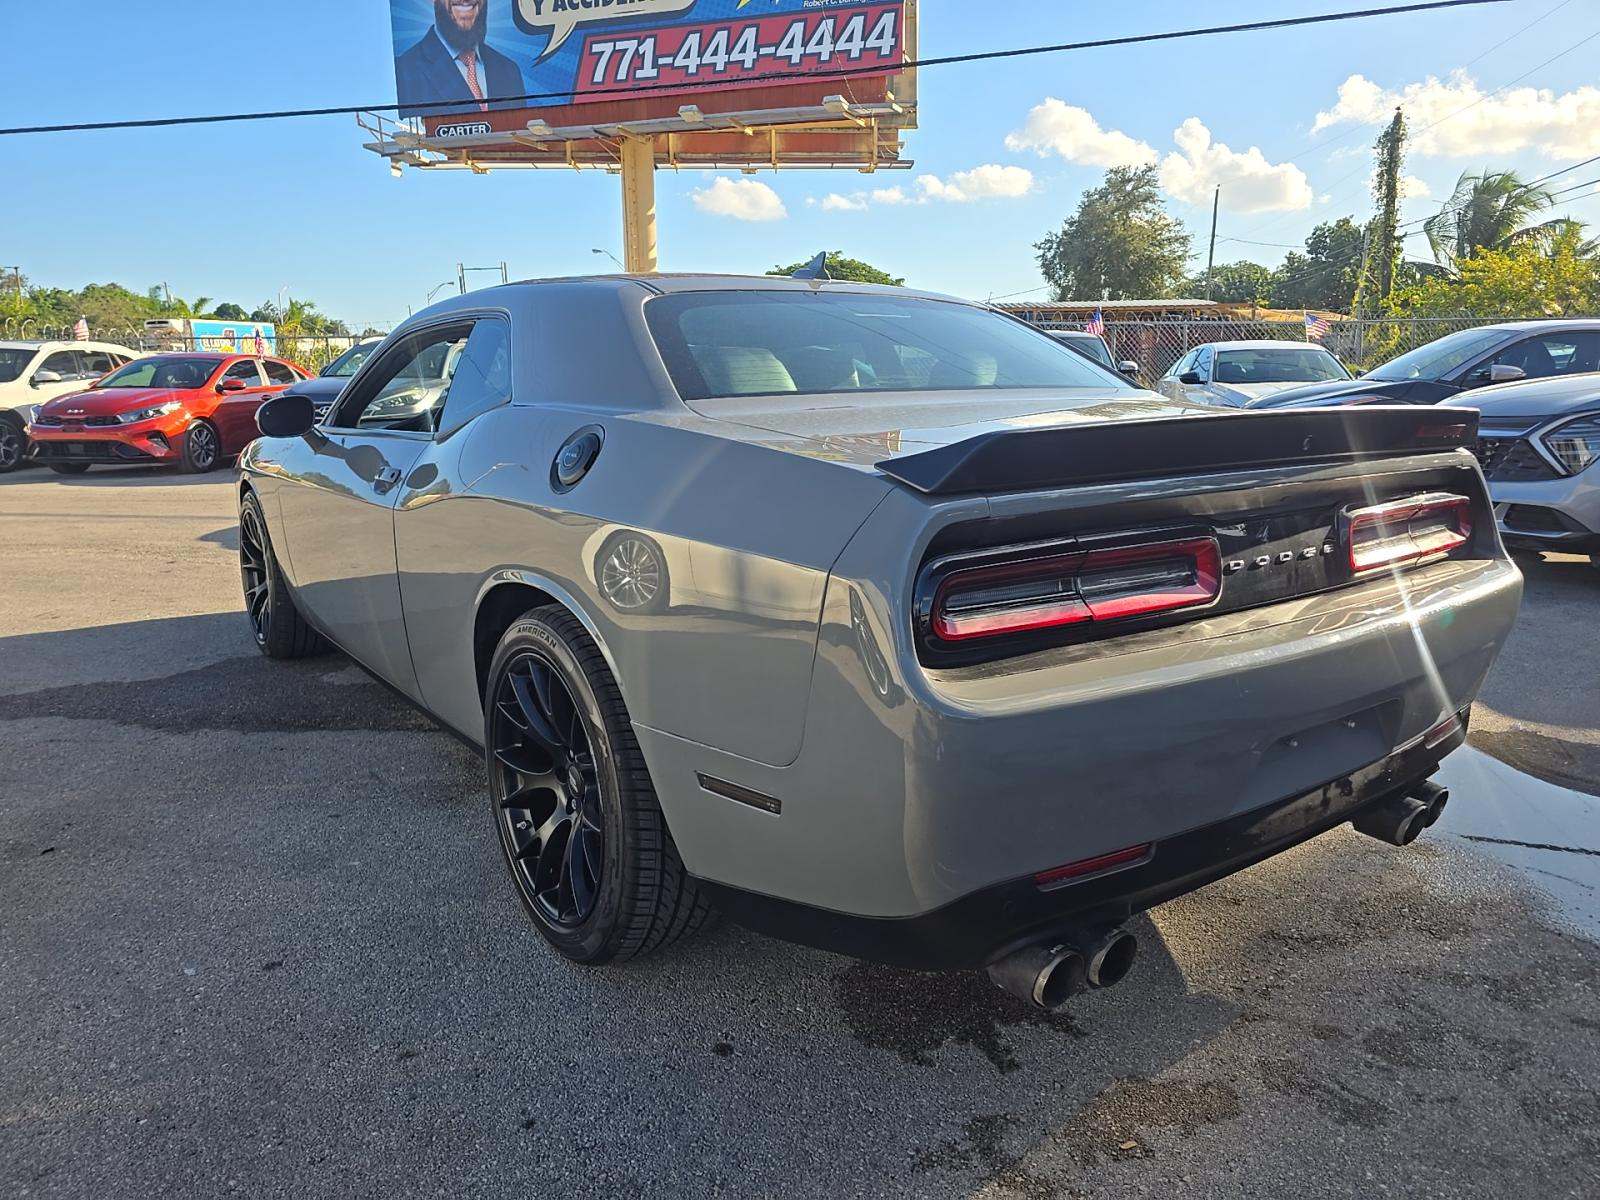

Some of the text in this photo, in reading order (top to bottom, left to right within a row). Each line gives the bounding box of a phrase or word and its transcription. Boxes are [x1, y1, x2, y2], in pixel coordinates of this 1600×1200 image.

[591, 12, 896, 83] 771-444-4444
[439, 124, 486, 137] CARTER
[1229, 544, 1335, 571] DODGE
[517, 625, 557, 648] AMERICAN
